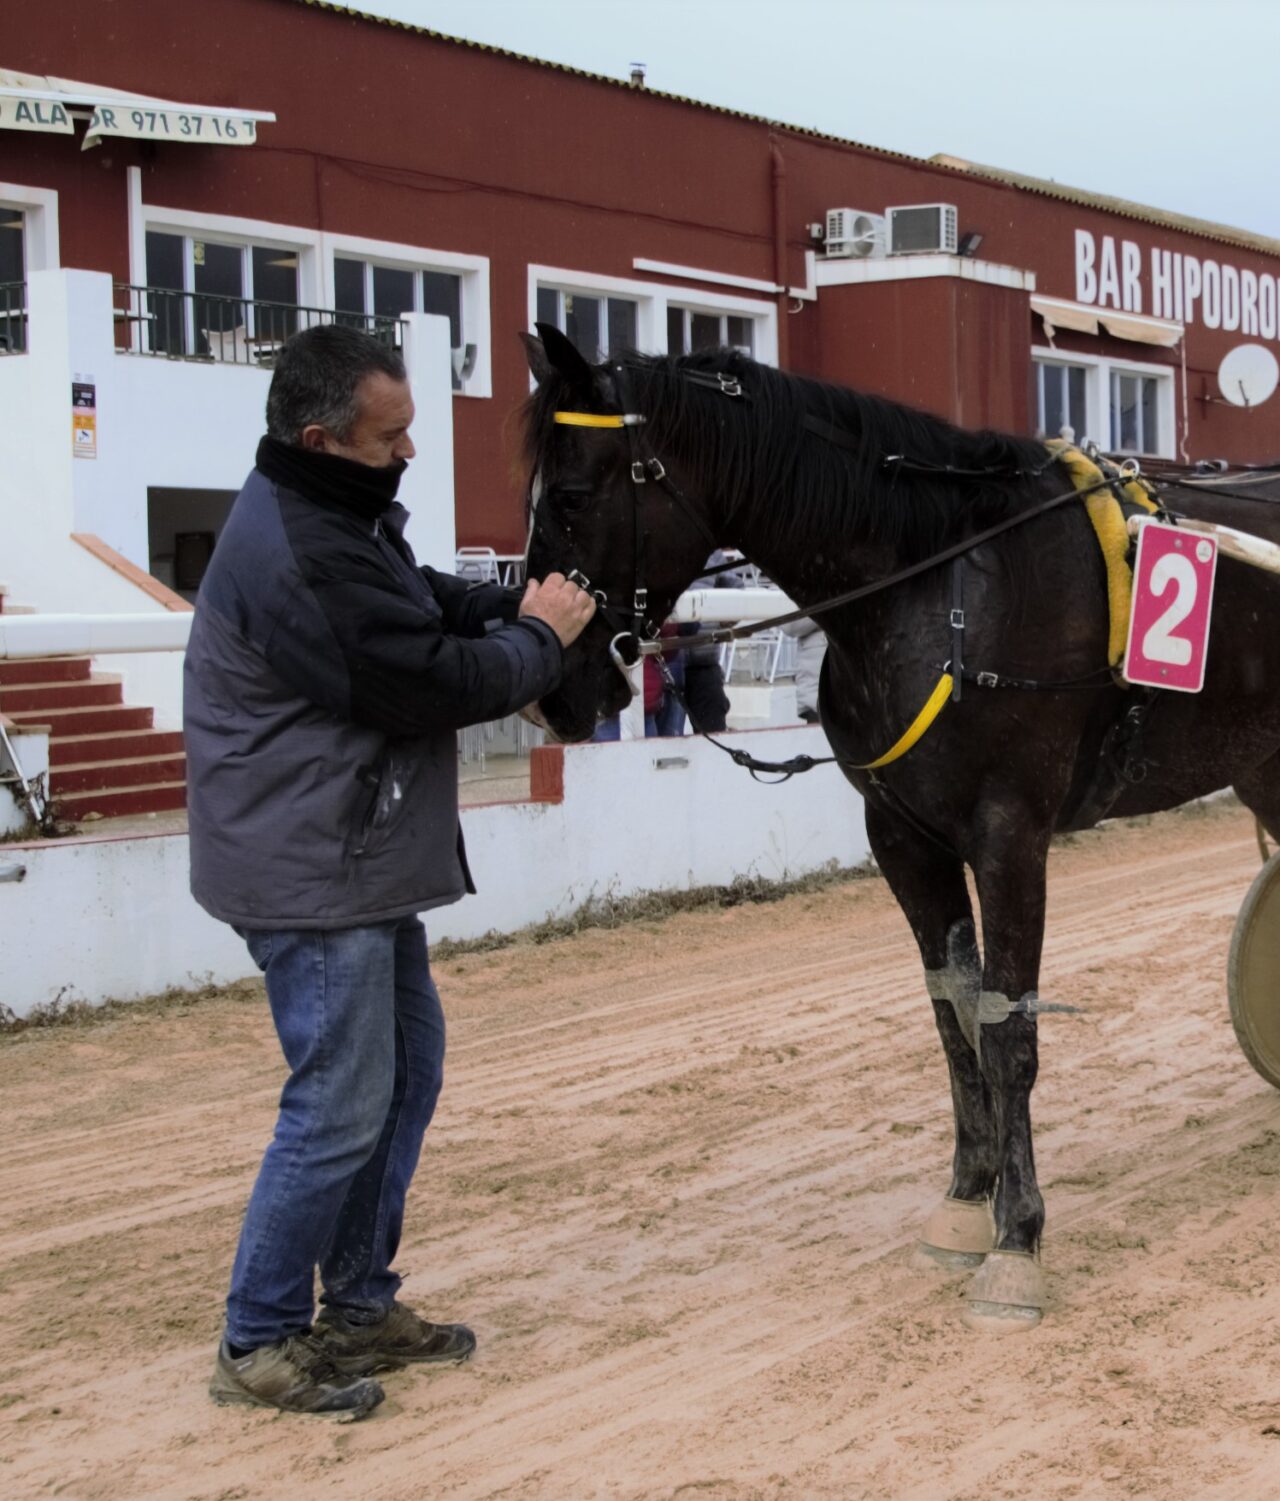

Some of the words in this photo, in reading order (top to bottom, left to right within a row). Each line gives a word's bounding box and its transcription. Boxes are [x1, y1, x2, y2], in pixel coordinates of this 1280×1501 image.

[131, 111, 169, 133] 971
[178, 115, 202, 136] 37
[1075, 229, 1142, 313] BAR
[1142, 553, 1197, 666] 2
